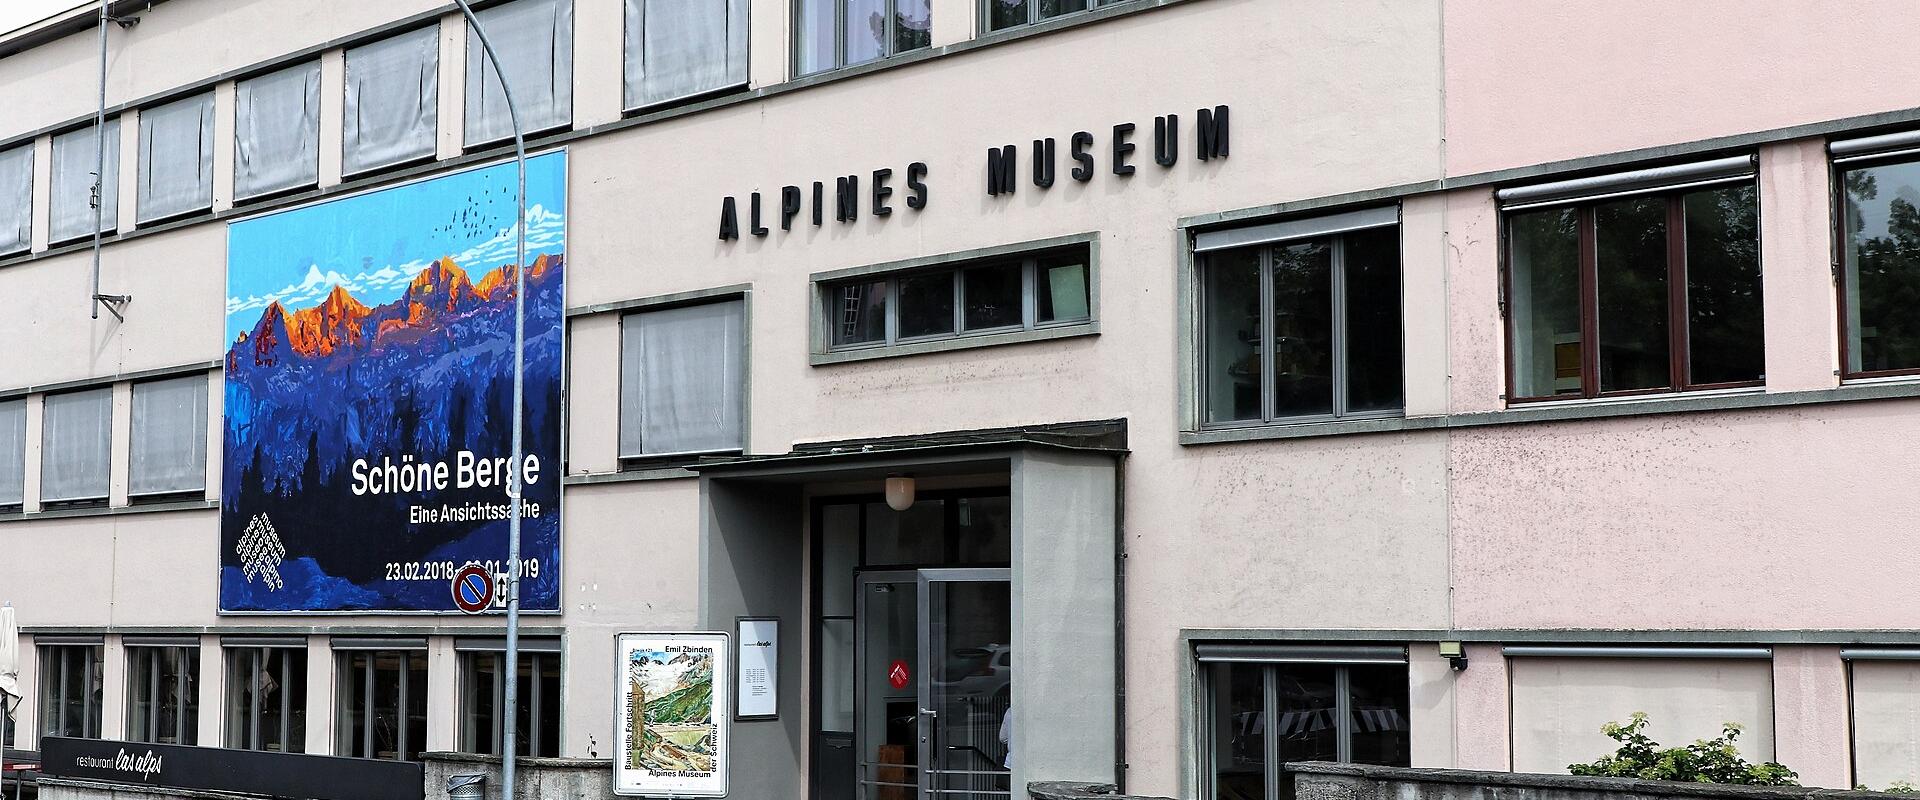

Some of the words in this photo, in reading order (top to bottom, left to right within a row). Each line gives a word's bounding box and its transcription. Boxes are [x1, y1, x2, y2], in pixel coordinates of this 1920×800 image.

[718, 161, 929, 242] ALPINES
[987, 104, 1230, 197] MUSEUM
[351, 454, 449, 496] Schöne
[410, 505, 438, 524] Eine
[236, 514, 259, 554] alpines
[260, 511, 286, 559] museum
[240, 529, 260, 563] alpine
[257, 520, 281, 567] museum
[665, 645, 681, 653] Emil
[682, 645, 713, 654] Zbinden
[76, 755, 114, 769] restaurant
[115, 747, 134, 772] las
[134, 749, 162, 782] alps
[648, 769, 677, 778] Alpines
[678, 769, 711, 778] Museum
